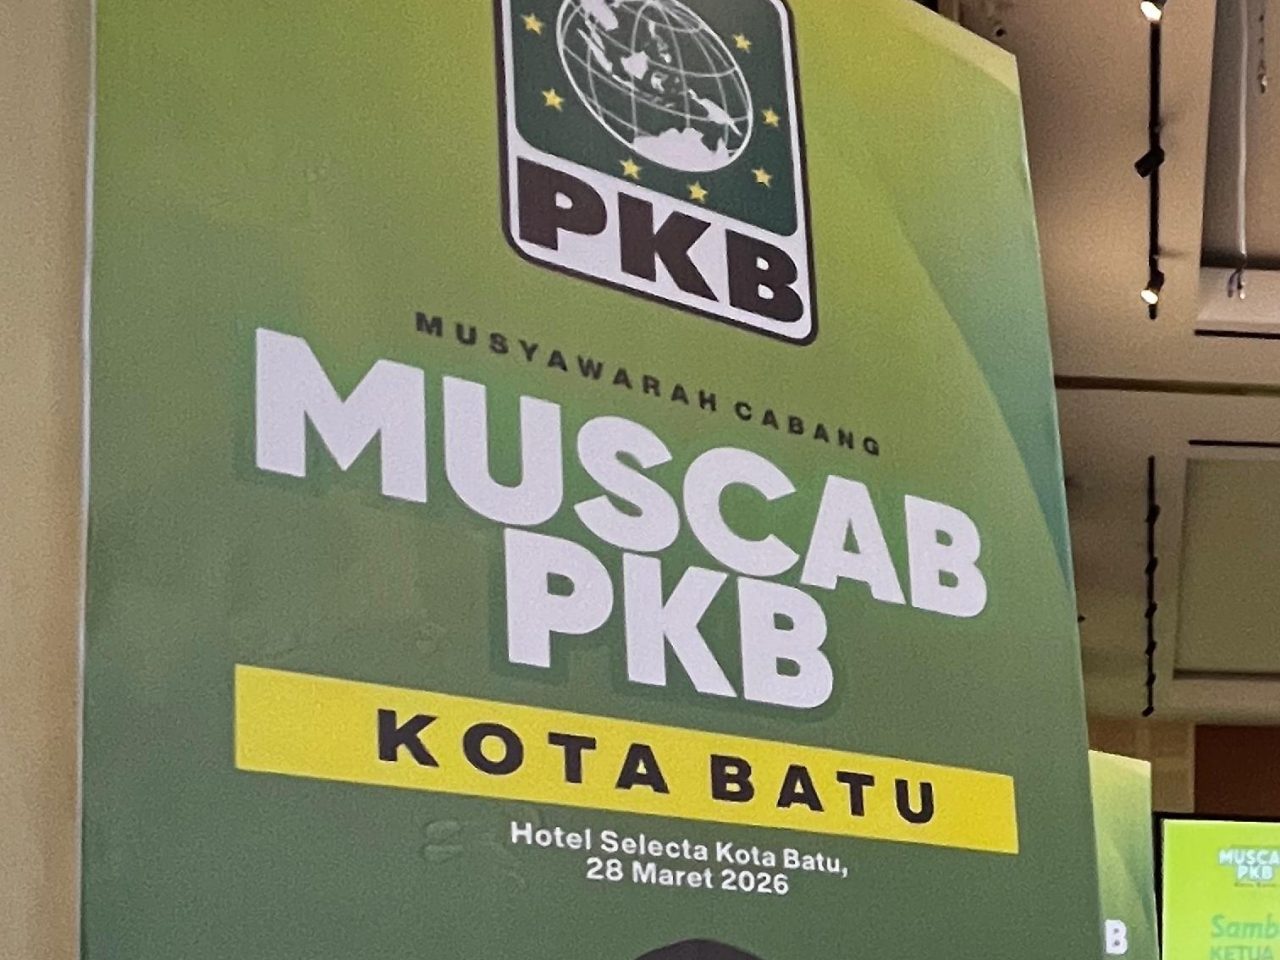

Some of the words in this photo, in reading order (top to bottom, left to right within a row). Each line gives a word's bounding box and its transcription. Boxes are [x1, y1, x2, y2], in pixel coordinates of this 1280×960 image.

[516, 157, 804, 324] PKB
[416, 312, 717, 412] MUSYAWARAH
[734, 402, 881, 456] CABANG
[256, 327, 987, 619] MUSCAB
[504, 527, 834, 709] PKB
[376, 709, 670, 795] KOTA
[710, 755, 936, 826] BATU
[510, 821, 592, 850] Hotel
[600, 830, 708, 862] Selecta
[715, 842, 776, 868] Kota
[783, 848, 849, 878] Batu,
[586, 857, 624, 881] 28
[632, 860, 714, 889] Maret
[720, 869, 790, 895] 2026
[1237, 865, 1273, 880] PKB
